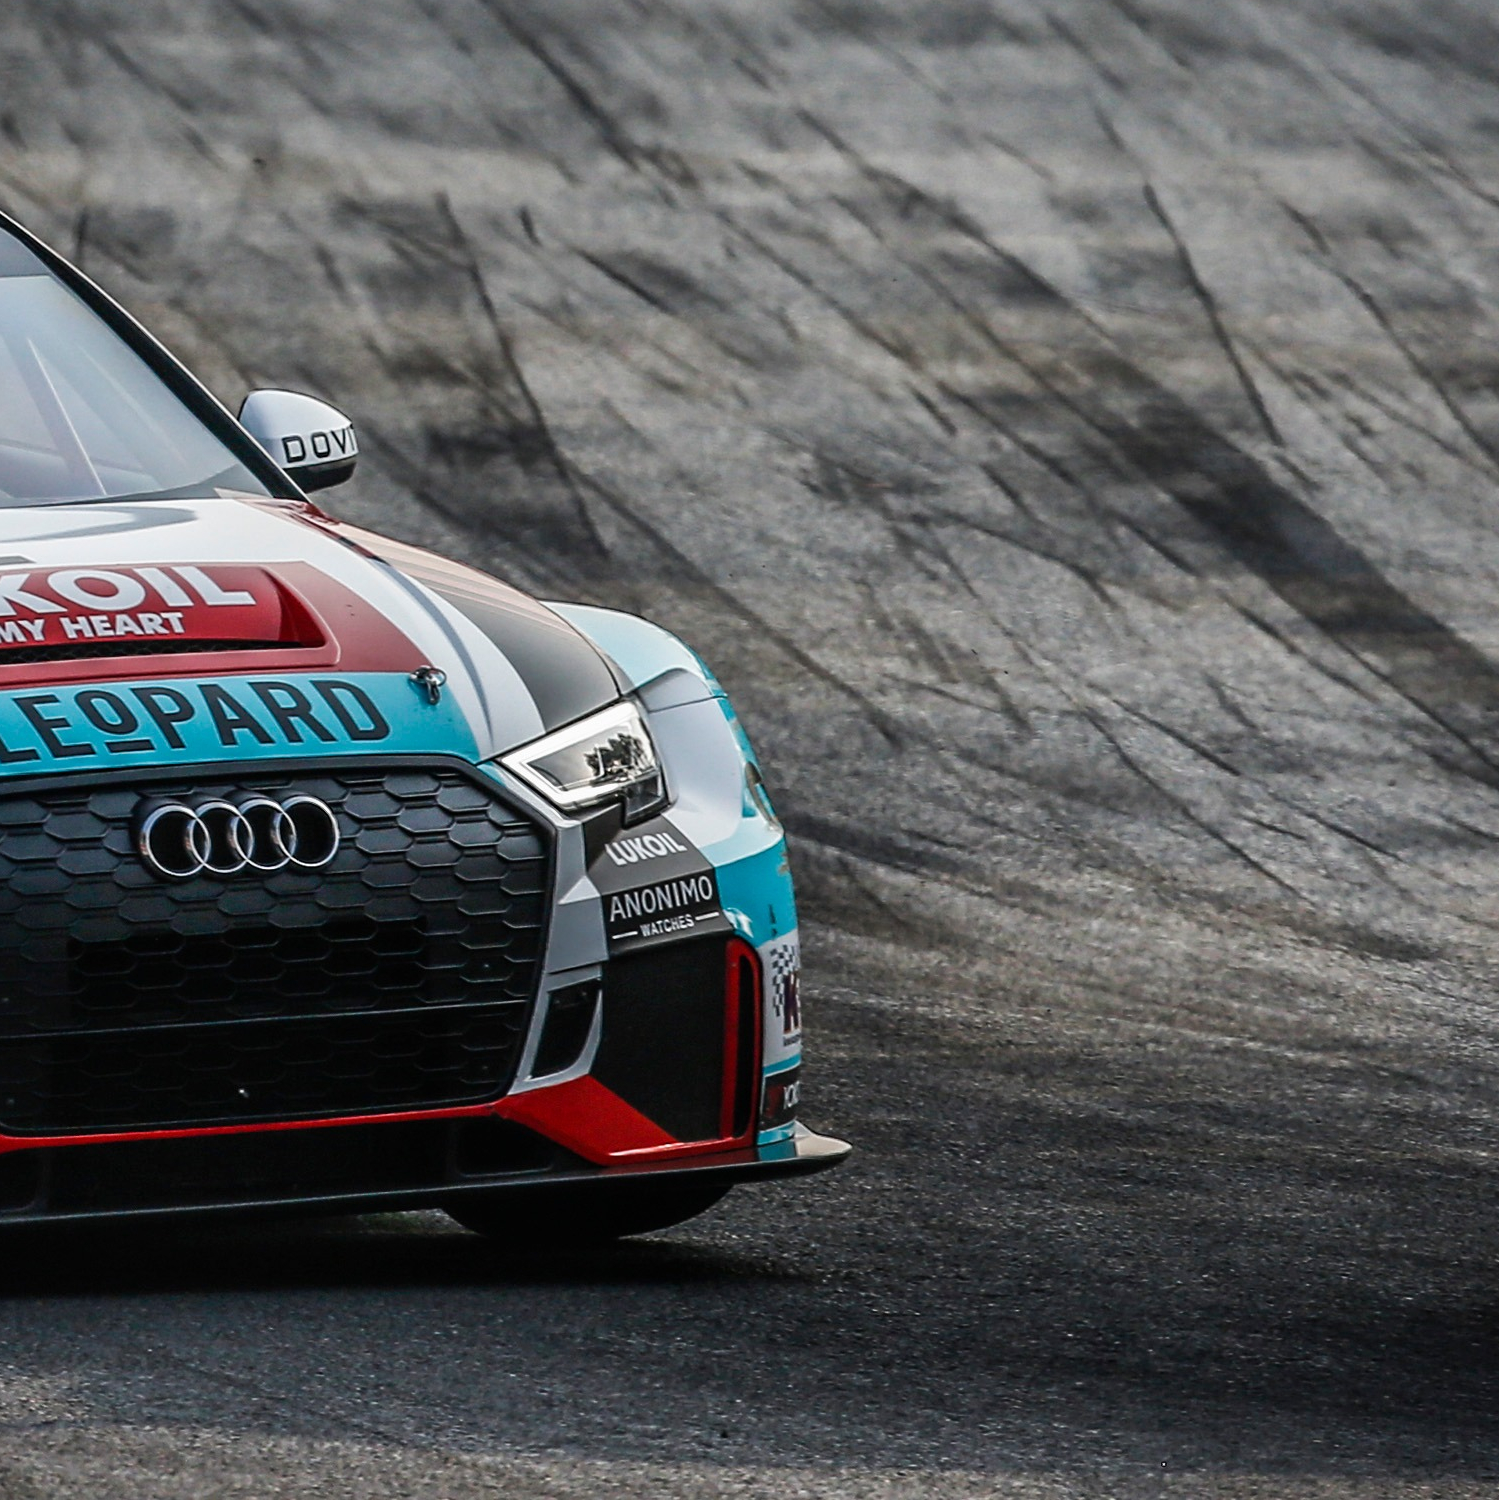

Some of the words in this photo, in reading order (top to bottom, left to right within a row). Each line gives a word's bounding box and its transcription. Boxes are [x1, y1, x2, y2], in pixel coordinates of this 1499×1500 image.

[62, 611, 185, 641] HEART
[605, 832, 688, 866] LUKOIL
[610, 875, 713, 922] ANONIMO
[639, 913, 695, 937] WATCHES
